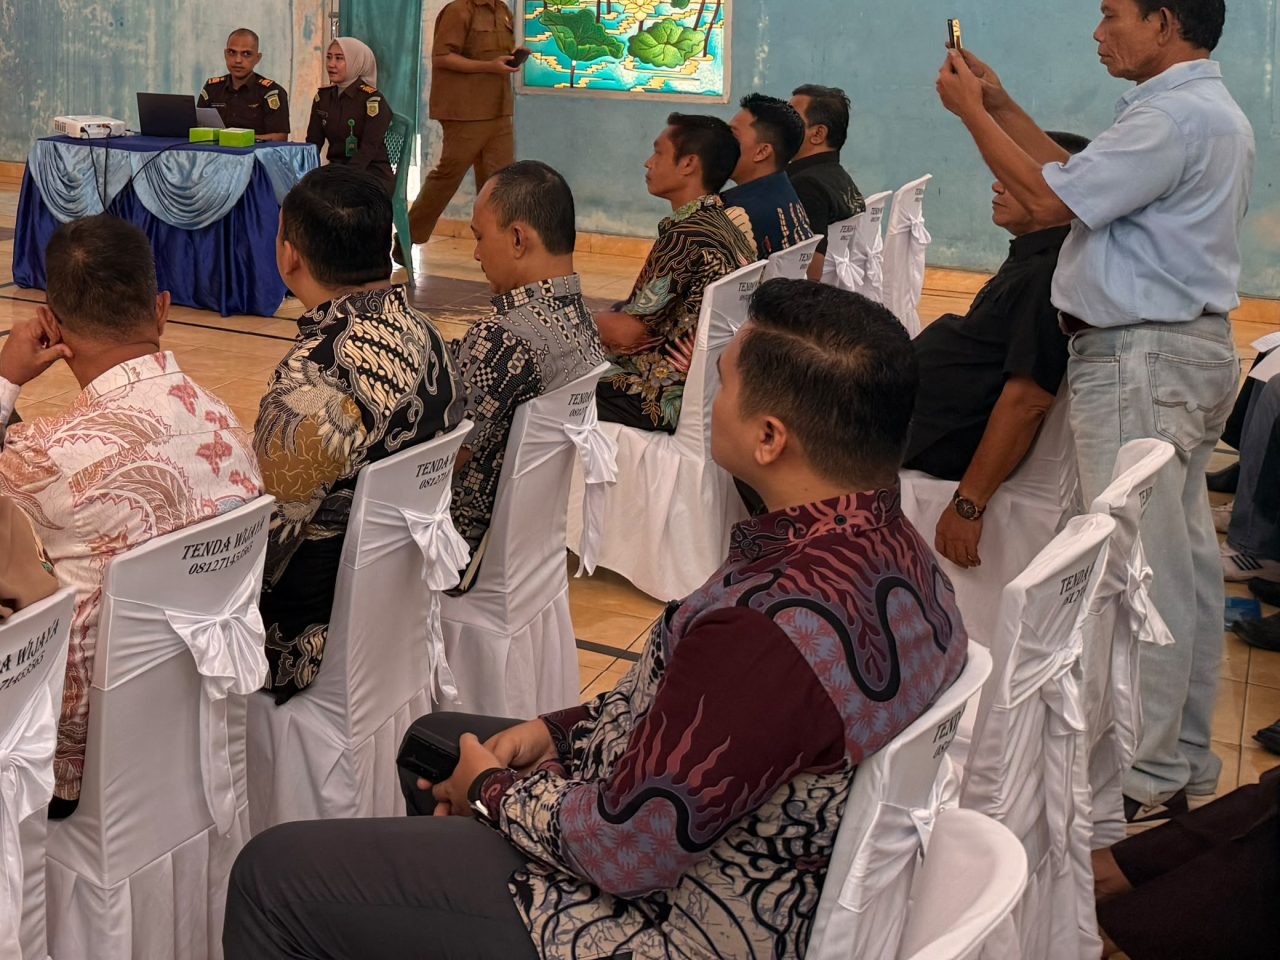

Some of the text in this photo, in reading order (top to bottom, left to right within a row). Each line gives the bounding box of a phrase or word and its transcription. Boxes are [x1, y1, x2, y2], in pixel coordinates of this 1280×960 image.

[416, 455, 449, 478] TENDA
[181, 536, 231, 560] TENDA
[16, 617, 60, 666] WIJAYA
